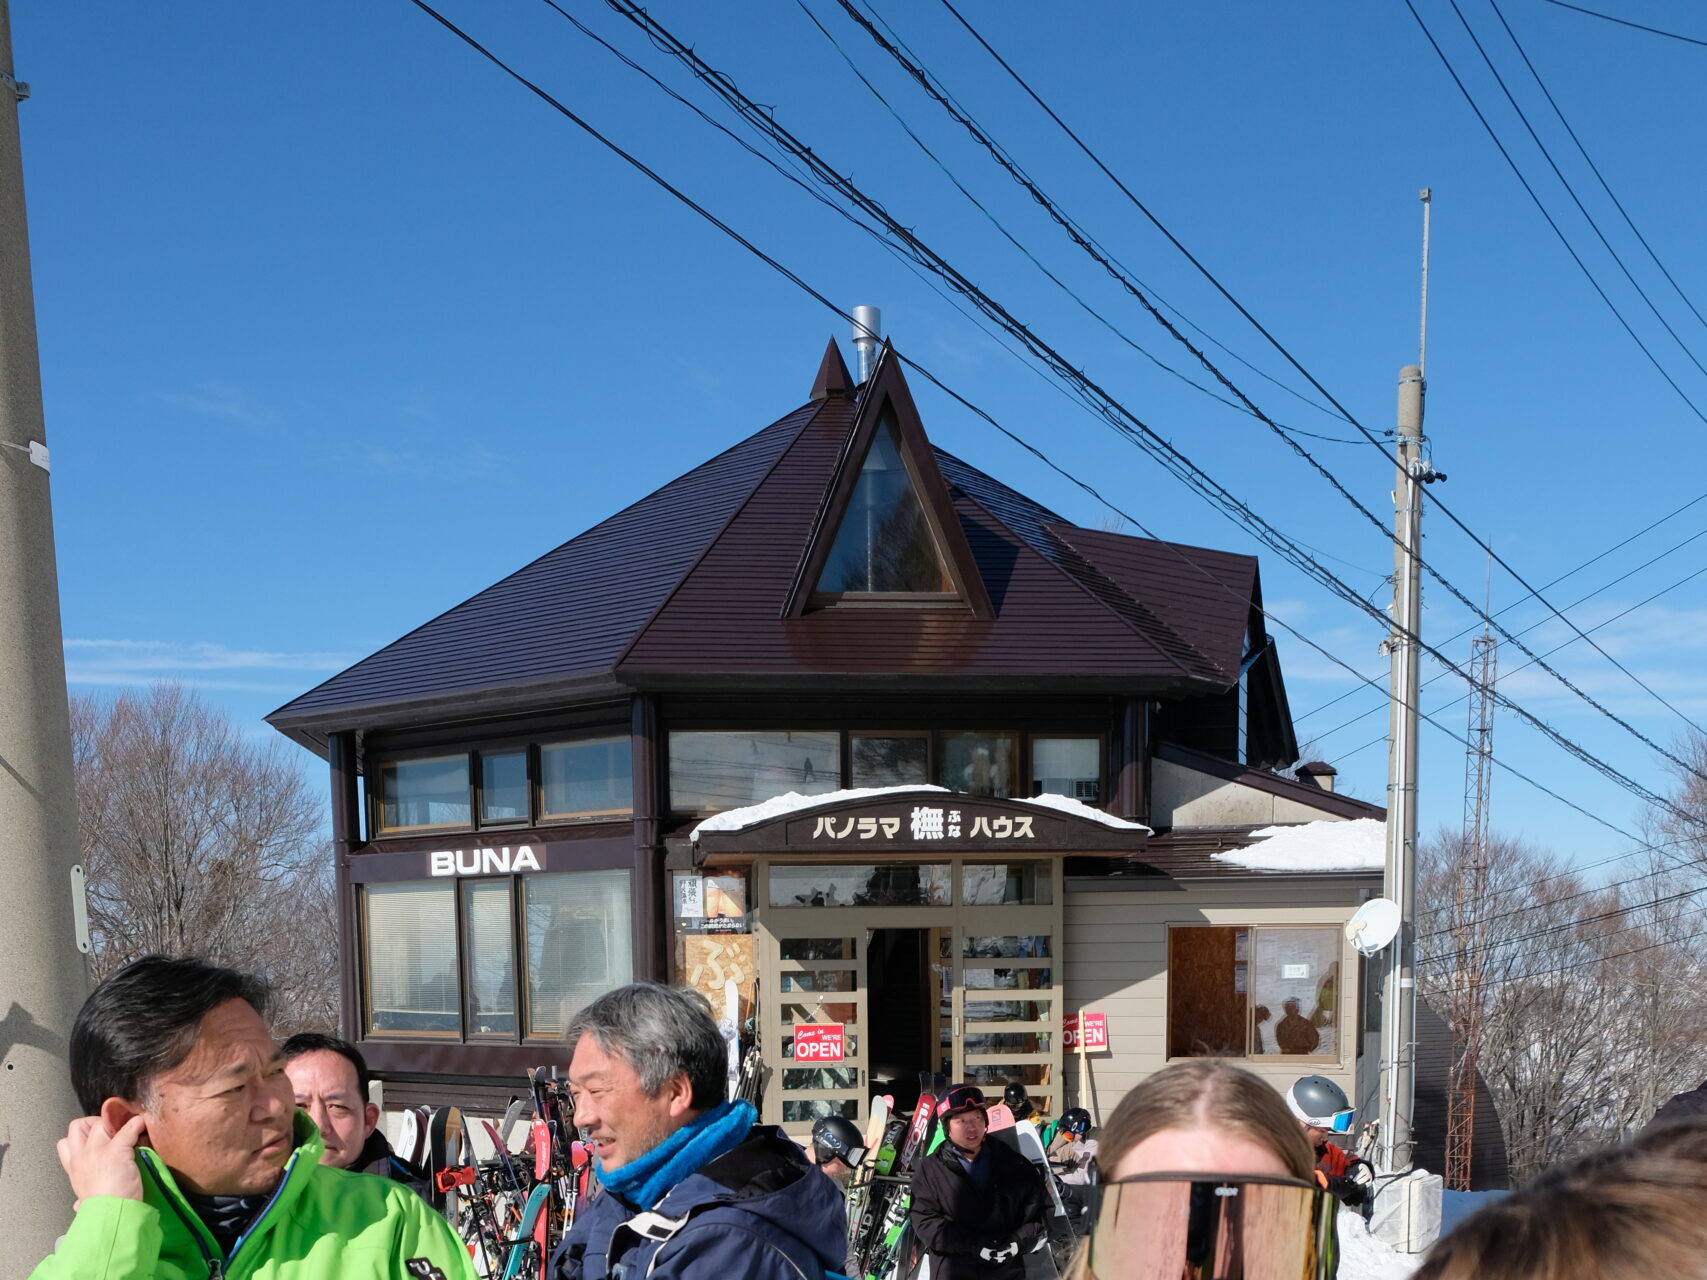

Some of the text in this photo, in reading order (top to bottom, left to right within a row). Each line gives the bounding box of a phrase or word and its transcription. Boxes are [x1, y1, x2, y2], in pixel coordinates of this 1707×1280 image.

[812, 817, 900, 839] パノラマ
[948, 810, 962, 838] ぶな
[970, 816, 1035, 838] ハウス
[431, 845, 541, 877] BUNA
[797, 1030, 816, 1040] Come
[796, 1042, 841, 1058] OPEN
